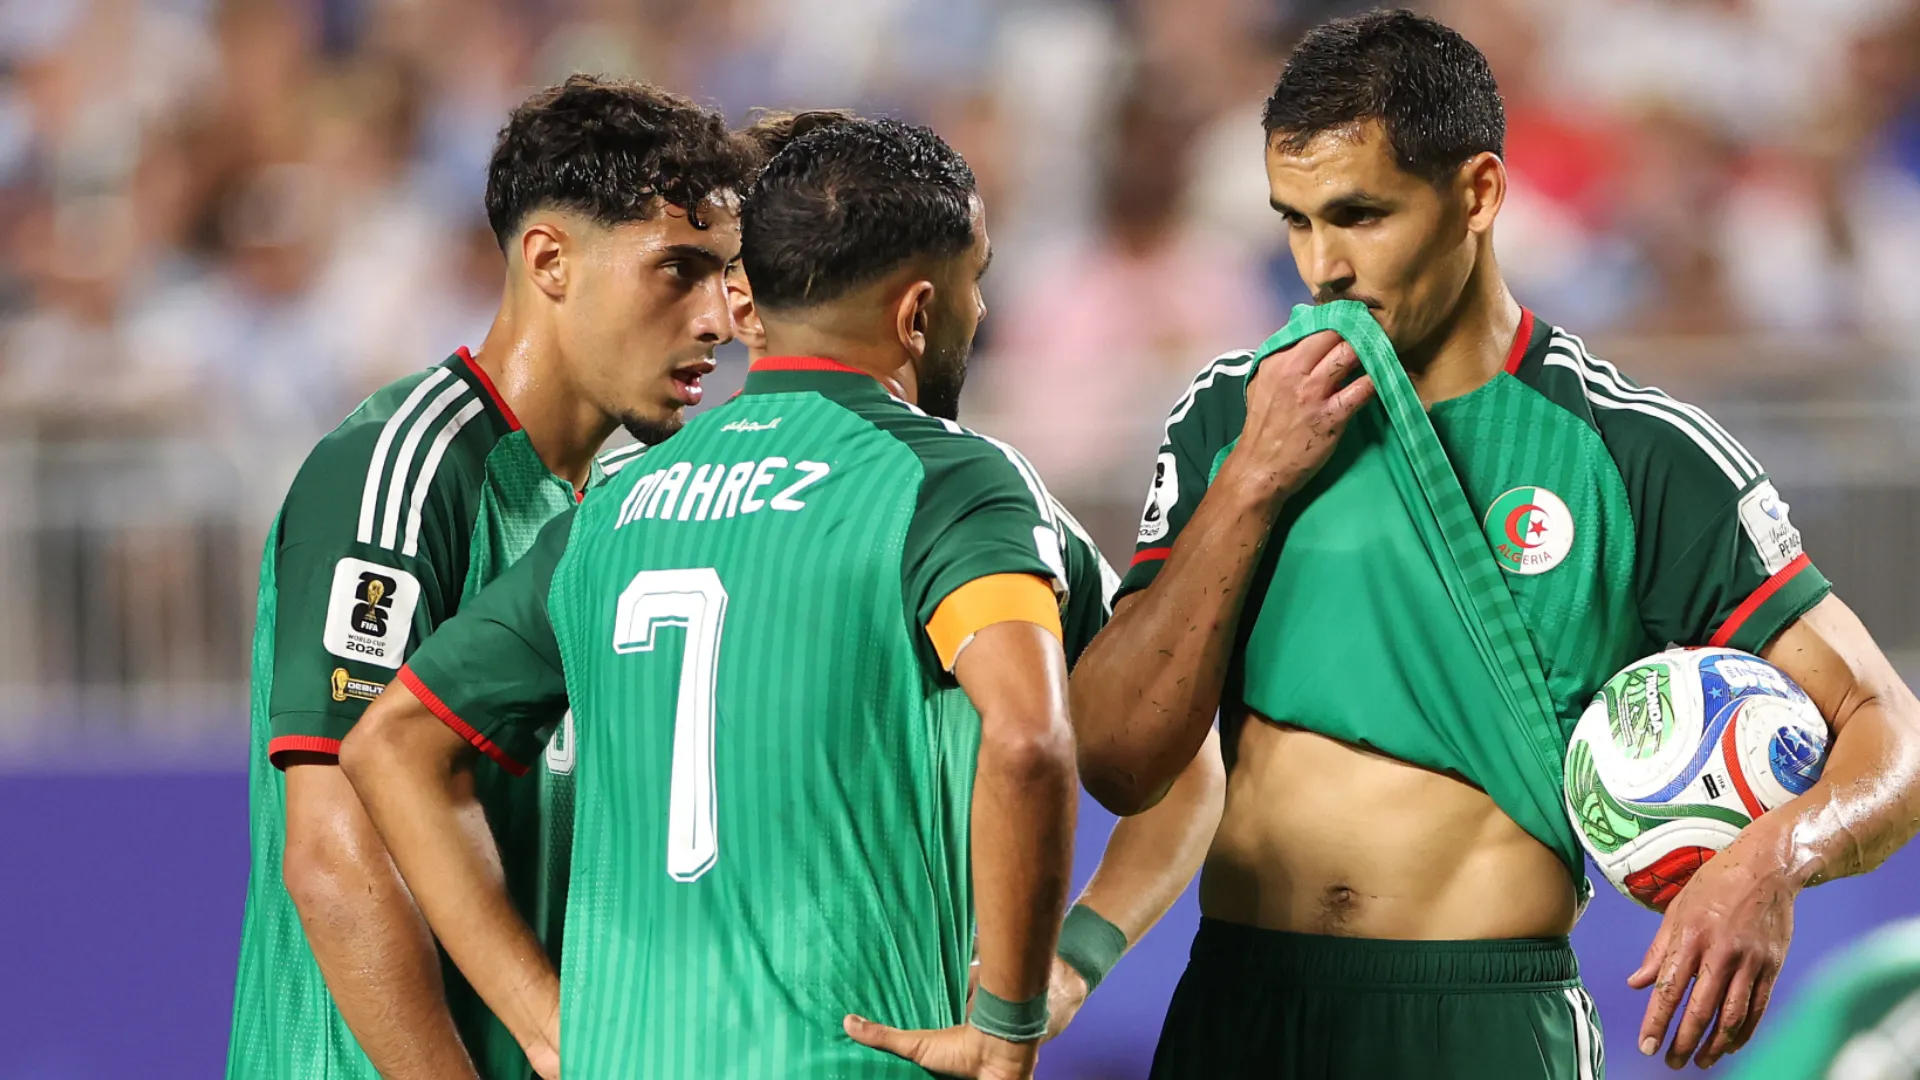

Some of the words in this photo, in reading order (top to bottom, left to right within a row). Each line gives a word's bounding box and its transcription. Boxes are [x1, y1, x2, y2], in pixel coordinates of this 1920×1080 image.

[614, 456, 831, 530] MAHREZ
[1496, 544, 1552, 565] ALGERIA
[361, 620, 379, 632] FIFA
[345, 641, 385, 657] 2026
[347, 634, 372, 645] WORLD
[372, 639, 386, 648] CUP
[347, 682, 384, 694] DEBUT
[1645, 670, 1663, 734] TRIONDA
[613, 568, 729, 883] 7
